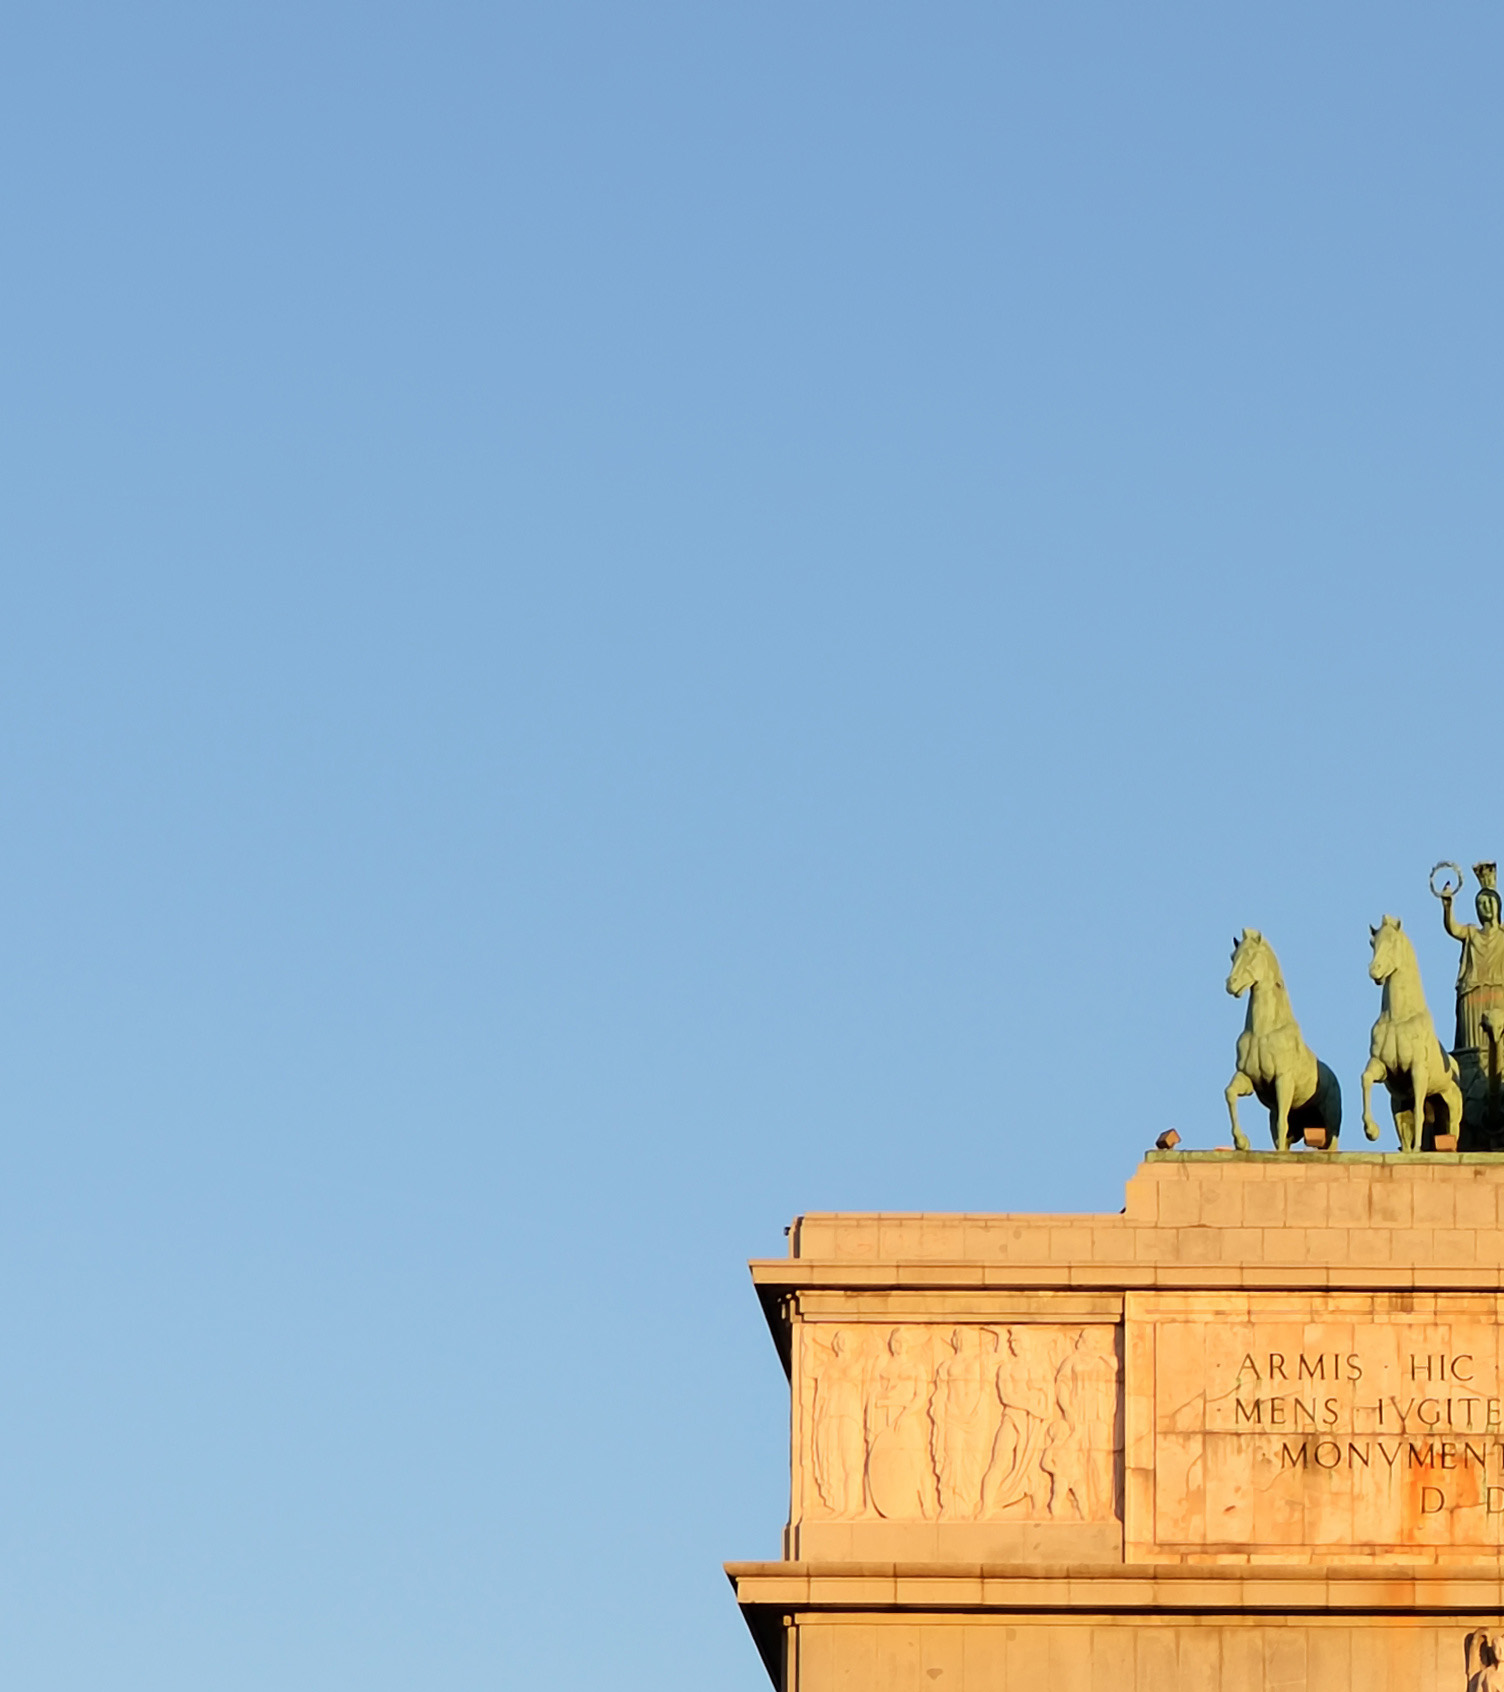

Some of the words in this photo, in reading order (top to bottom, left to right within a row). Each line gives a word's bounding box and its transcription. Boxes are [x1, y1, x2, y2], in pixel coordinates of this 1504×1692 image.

[1237, 1353, 1362, 1381] ARMIS
[1409, 1353, 1475, 1382] HIC
[1234, 1397, 1338, 1425] MENS
